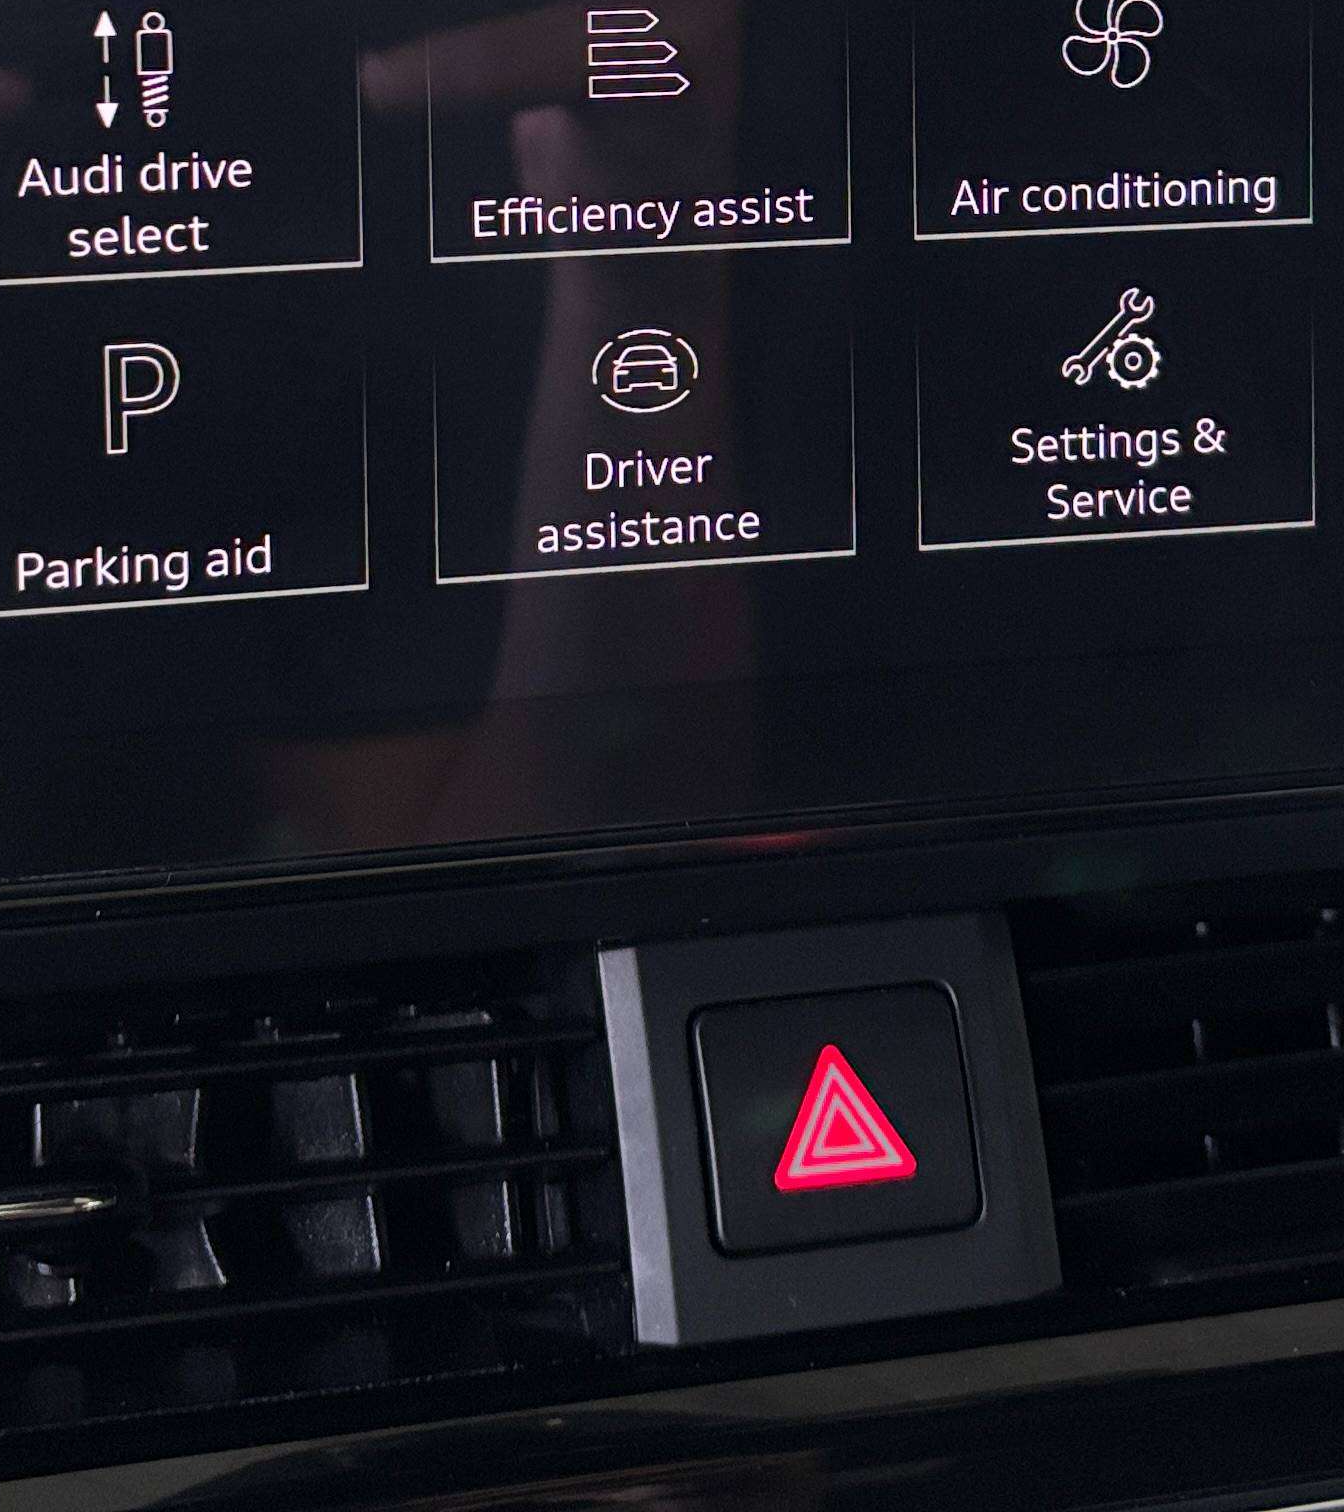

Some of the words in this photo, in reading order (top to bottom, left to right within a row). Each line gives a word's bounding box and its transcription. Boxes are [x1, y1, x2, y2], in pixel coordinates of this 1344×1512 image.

[17, 153, 124, 199] Audi
[138, 151, 254, 193] drive
[950, 178, 1011, 217] Air
[1021, 169, 1277, 215] conditioning
[67, 215, 210, 258] select
[472, 195, 681, 241] Efficiency
[692, 187, 814, 228] assist
[104, 342, 181, 455] P
[1010, 423, 1181, 468] Settings
[1192, 416, 1227, 455] &
[585, 450, 714, 492] Driver
[1046, 478, 1193, 521] Service
[537, 511, 761, 555] assistance
[16, 545, 191, 593] Parking
[204, 533, 273, 580] aid
